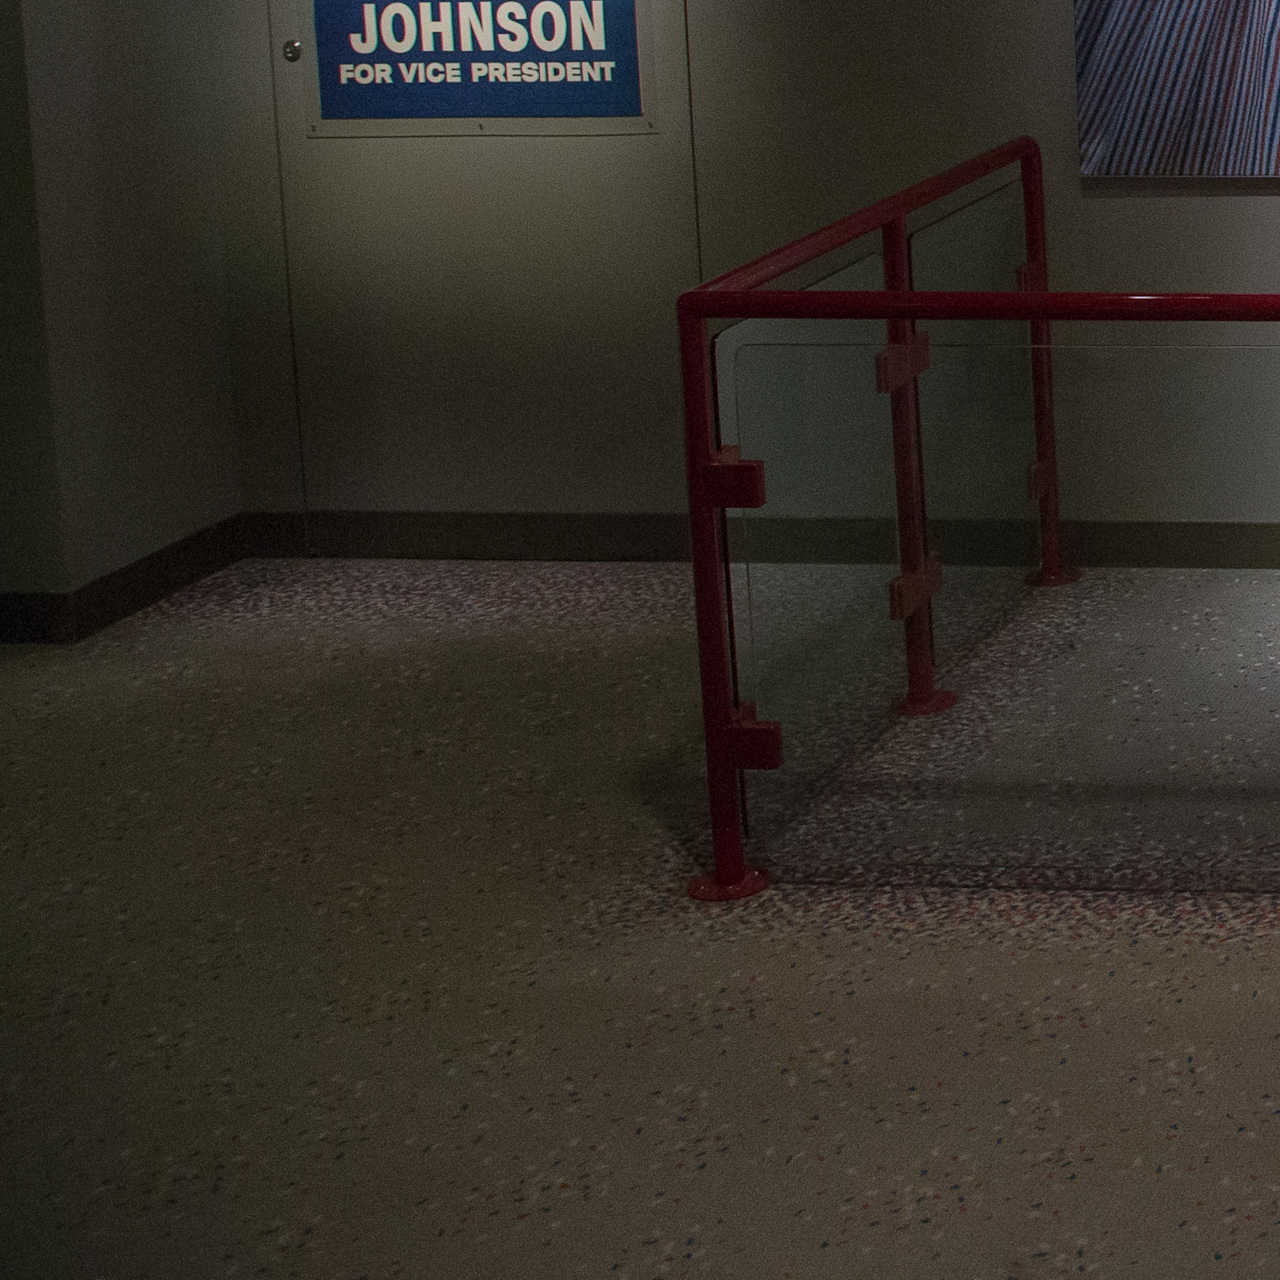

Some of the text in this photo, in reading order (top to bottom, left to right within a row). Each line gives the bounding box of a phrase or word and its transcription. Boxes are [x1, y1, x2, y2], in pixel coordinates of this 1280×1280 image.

[349, 0, 607, 55] JOHNSON
[339, 60, 616, 85] FOR VICE PRESIDENT
